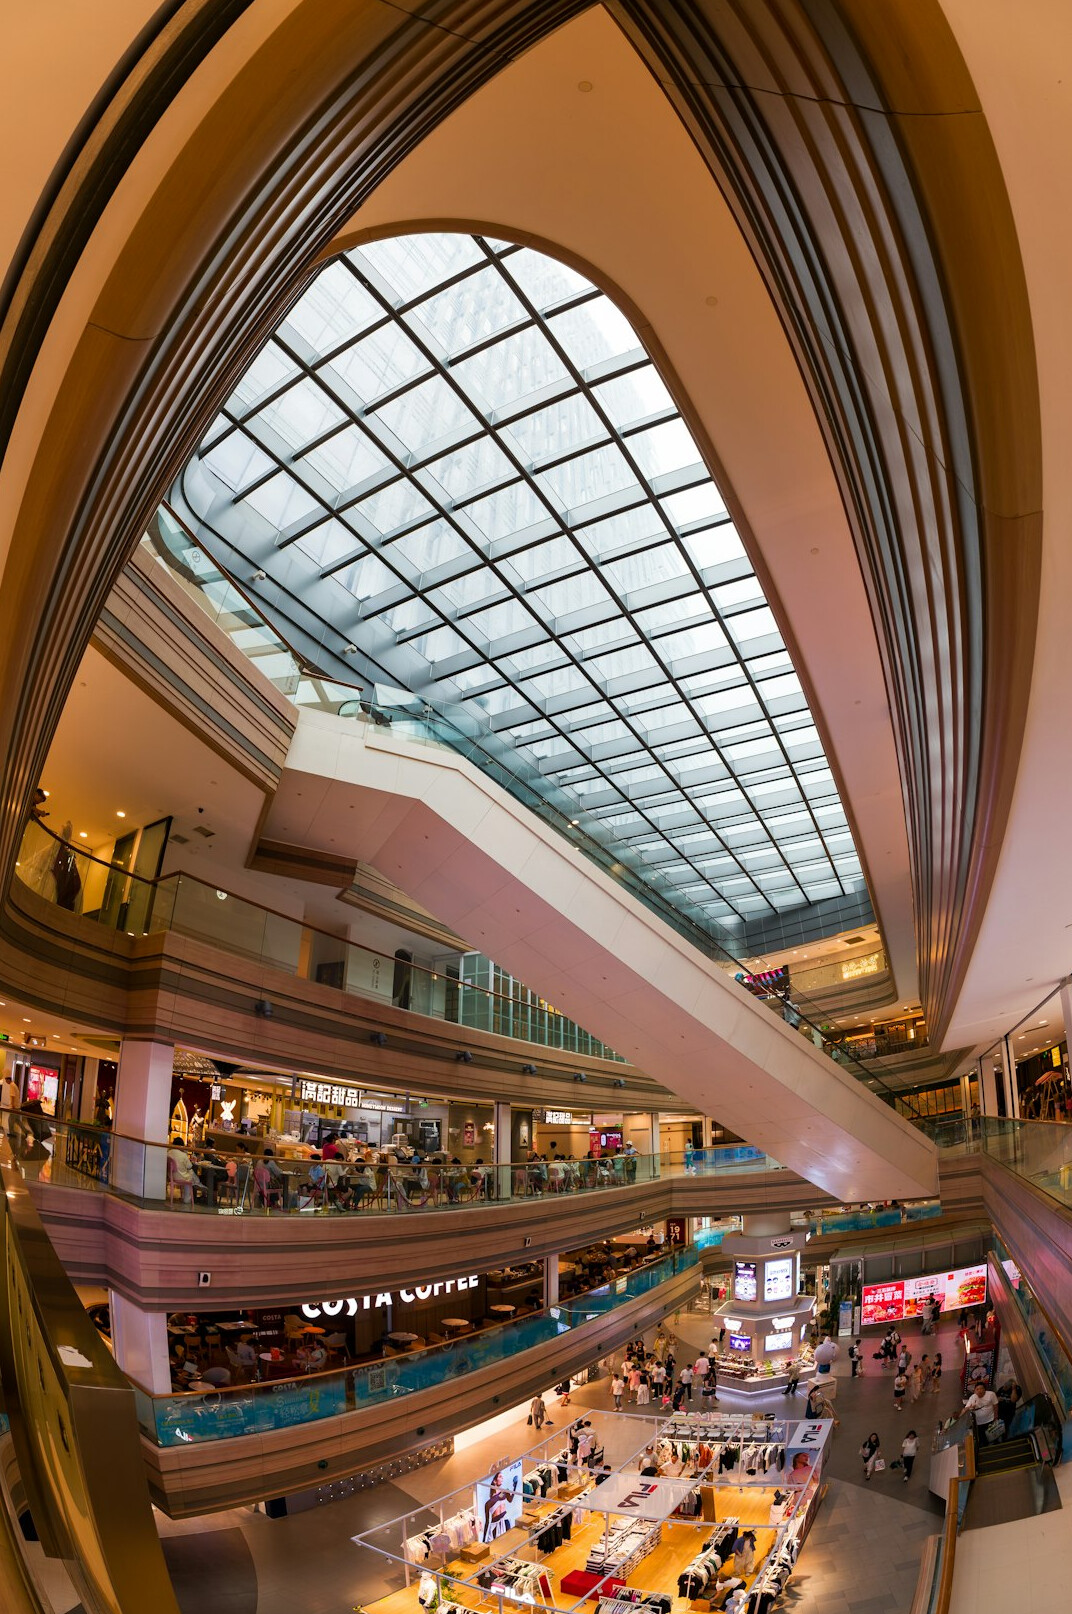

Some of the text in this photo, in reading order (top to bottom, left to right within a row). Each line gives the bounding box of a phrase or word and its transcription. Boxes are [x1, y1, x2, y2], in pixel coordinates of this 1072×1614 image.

[272, 1382, 297, 1393] COSTA
[800, 1424, 823, 1444] FILA
[509, 1461, 522, 1472] FILA
[617, 1483, 658, 1508] FILA
[490, 1581, 537, 1605] FILA
